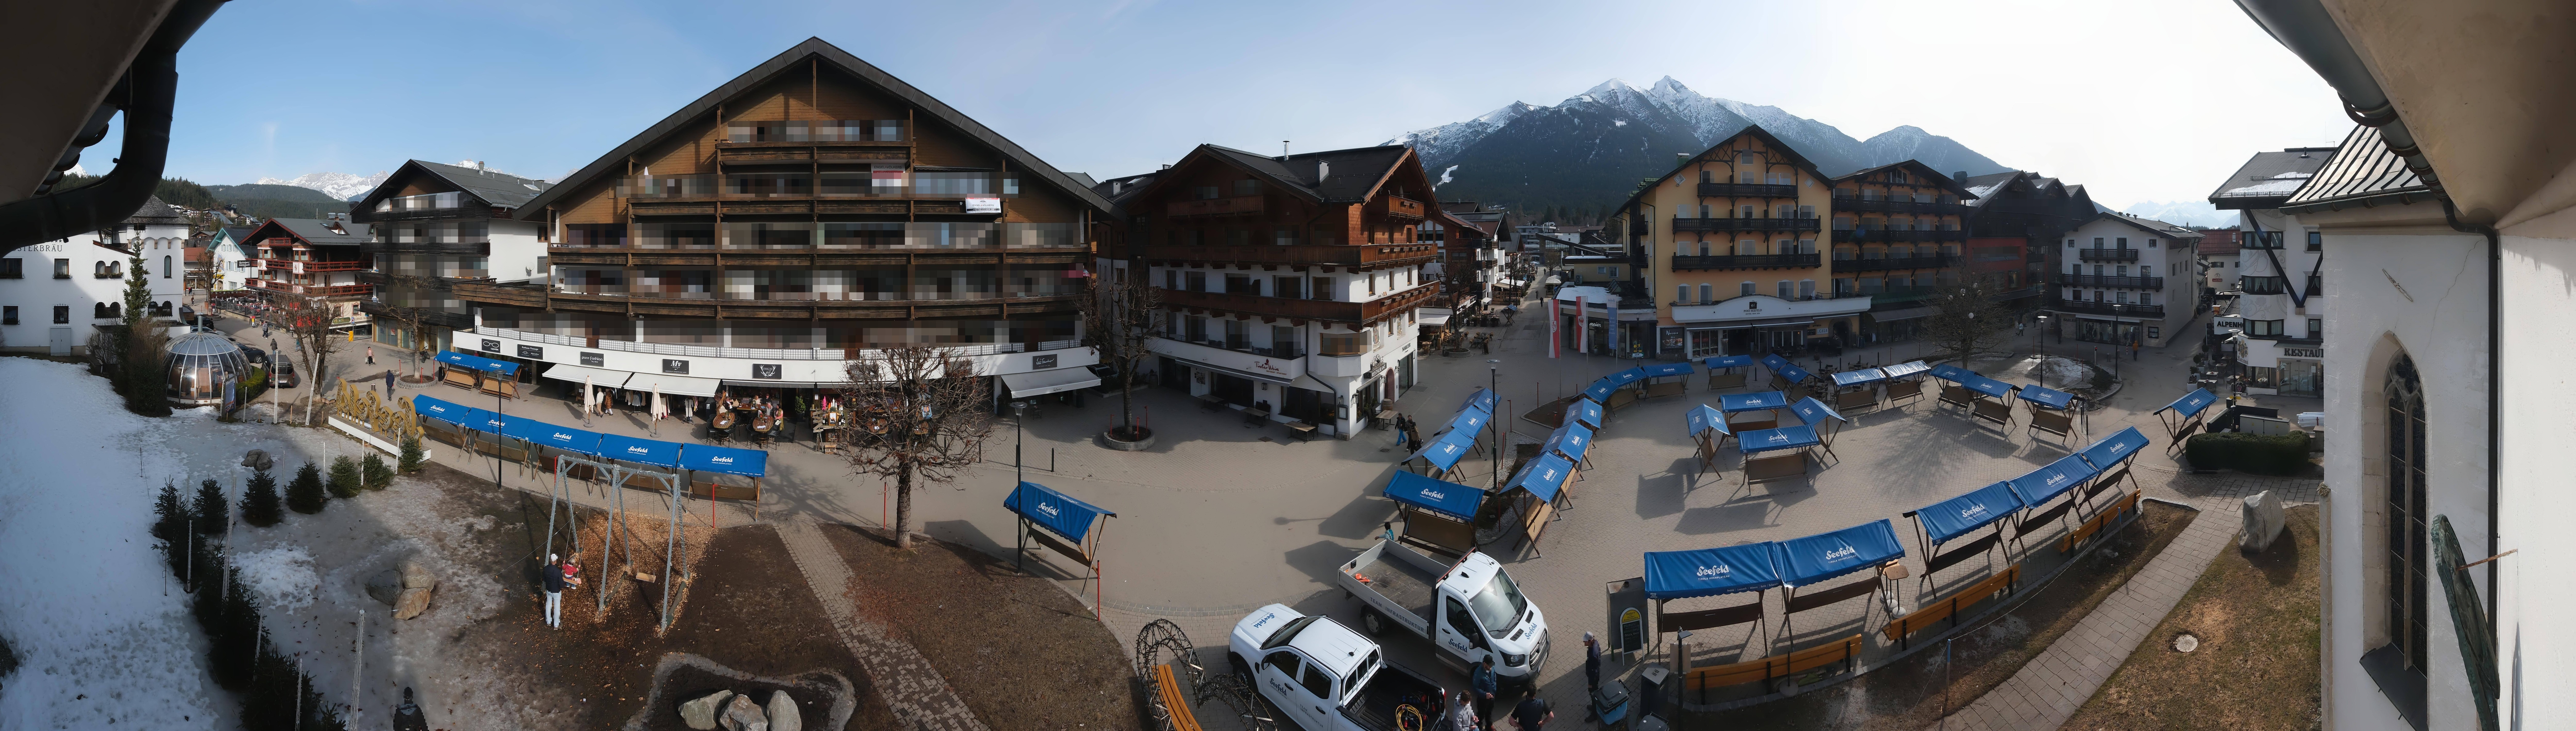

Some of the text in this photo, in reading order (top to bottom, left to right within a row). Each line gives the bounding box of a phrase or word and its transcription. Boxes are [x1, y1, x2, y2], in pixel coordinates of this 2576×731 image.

[2284, 348, 2323, 358] RESTAU
[1372, 364, 1386, 377] RESTAURANT
[1444, 443, 1455, 453] Seefeld
[2110, 442, 2124, 452] Seefeld
[1544, 469, 1554, 480] Seefeld
[2047, 473, 2065, 485] Seefeld
[1421, 489, 1444, 499] Seefeld
[1038, 502, 1060, 516] Seefeld
[1962, 503, 1985, 517] Seefeld
[1826, 545, 1855, 560] Seefeld
[1697, 565, 1729, 576] Seefeld
[1253, 613, 1275, 628] Seefeld
[1370, 597, 1424, 632] TEAM INFRASTRUKTUR
[1524, 623, 1537, 640] Seefeld
[1448, 639, 1467, 653] Seefeld
[1270, 678, 1287, 696] Seefeld
[1301, 708, 1323, 728] INFRASTRUKTUR
